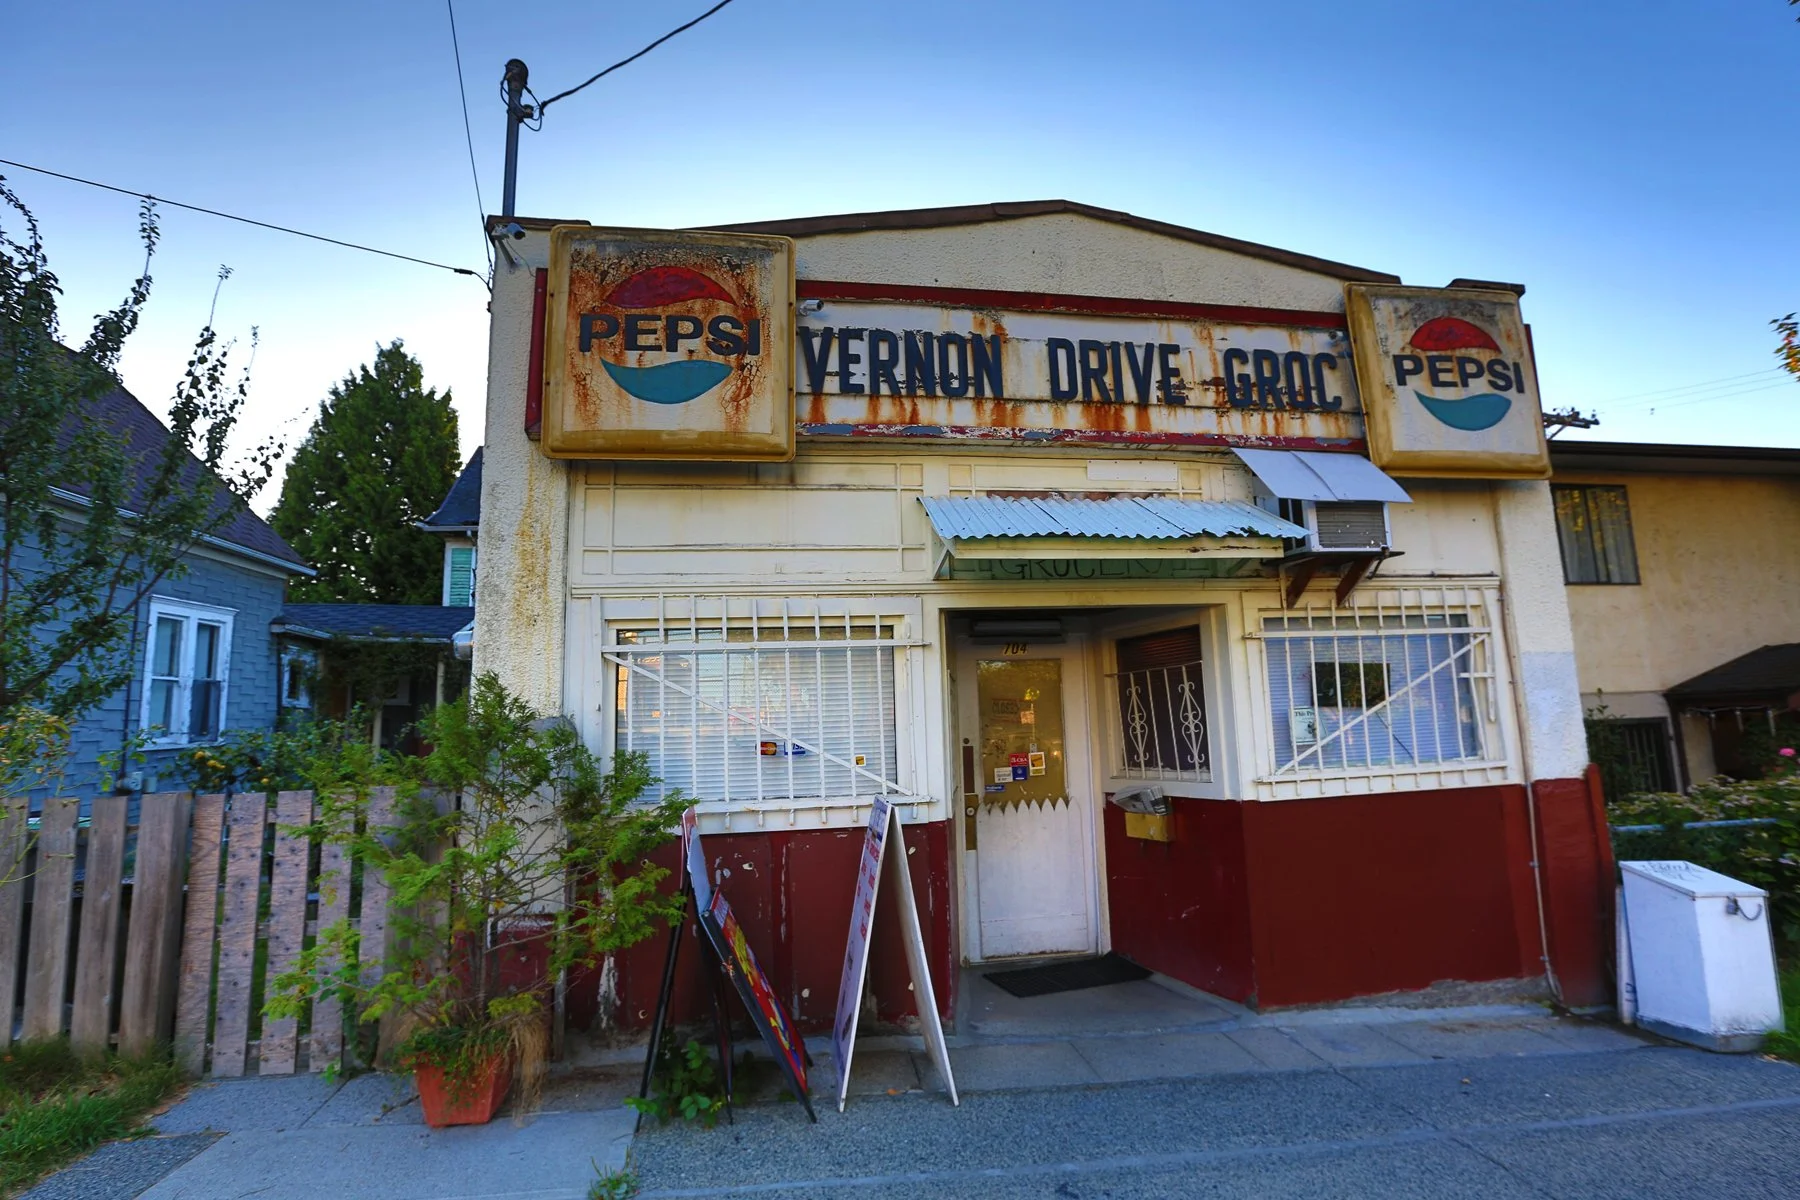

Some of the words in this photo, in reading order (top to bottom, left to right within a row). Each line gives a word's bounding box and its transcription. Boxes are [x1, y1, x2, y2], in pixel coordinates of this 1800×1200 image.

[579, 313, 761, 356] PEPSI
[798, 326, 1004, 398] VERNON
[1048, 337, 1187, 405] DRIVE
[1223, 348, 1342, 412] GROC
[1392, 354, 1525, 394] PEPSI
[1004, 643, 1027, 655] 704
